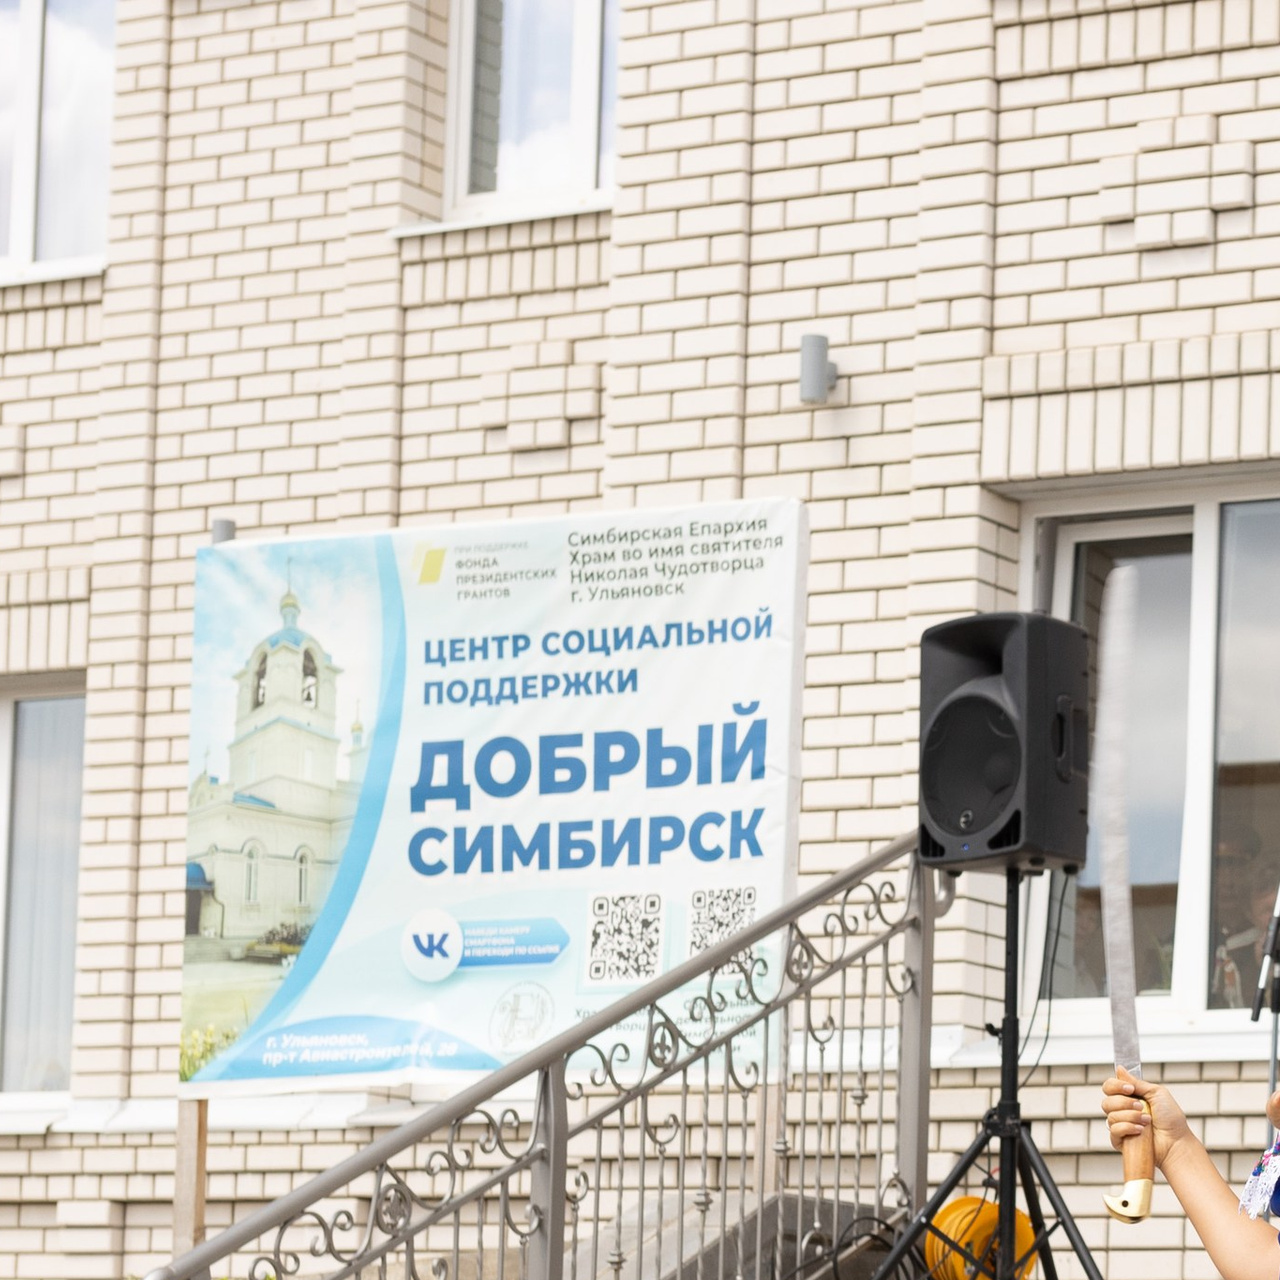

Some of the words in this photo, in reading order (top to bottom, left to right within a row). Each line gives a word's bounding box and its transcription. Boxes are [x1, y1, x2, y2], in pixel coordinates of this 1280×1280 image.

[567, 524, 683, 547] Симбирская
[689, 518, 768, 541] Епархия
[455, 556, 499, 570] ФОНДА
[569, 548, 616, 568] Храм
[622, 546, 643, 561] во
[649, 543, 684, 559] имя
[690, 535, 784, 556] святителя
[456, 567, 558, 586] ПРЕЗИДЕНТСКИХ
[570, 565, 649, 585] Николая
[655, 556, 764, 579] Чудотворца
[457, 586, 511, 601] ГРАНТОВ
[571, 588, 583, 602] г.
[588, 583, 685, 603] Ульяновск
[424, 633, 531, 667] ЦЕНТР
[542, 606, 774, 657] СОЦИАЛЬНОЙ
[423, 668, 639, 708] ПОДДЕРЖКИ
[410, 700, 768, 814] ДОБРЫЙ
[408, 807, 766, 877] СИМБИРСК
[281, 1033, 369, 1049] Ульяновск,
